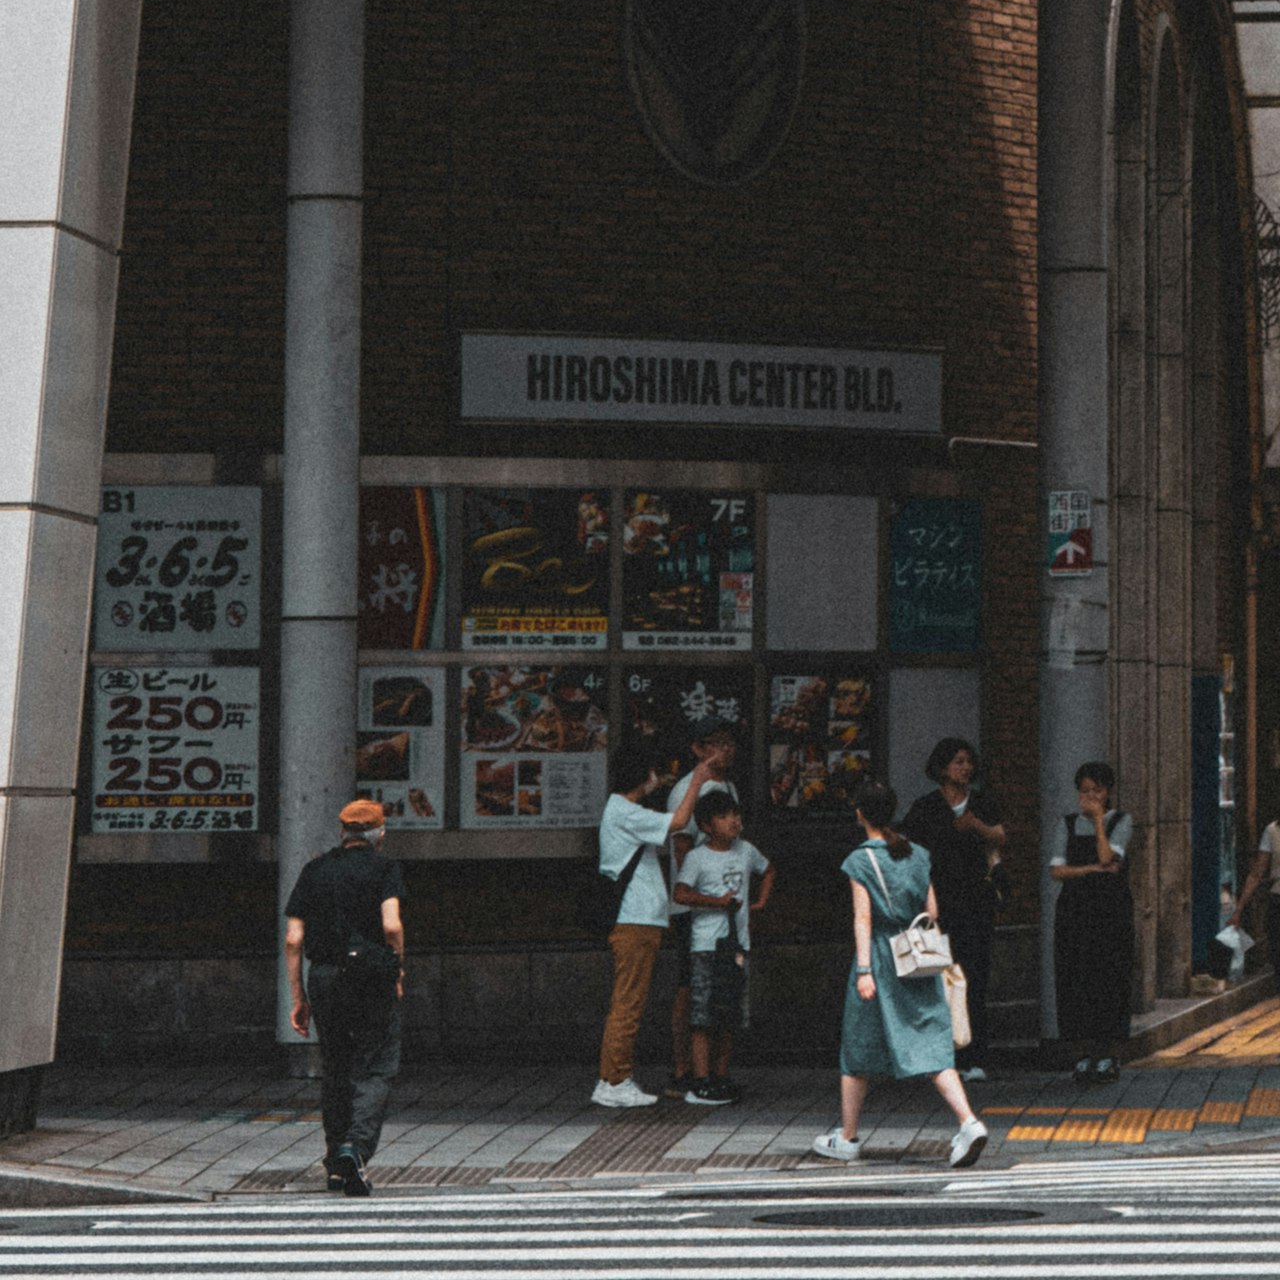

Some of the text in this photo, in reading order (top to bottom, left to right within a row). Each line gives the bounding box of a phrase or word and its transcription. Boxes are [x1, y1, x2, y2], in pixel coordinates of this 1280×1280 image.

[526, 353, 721, 406] HIROSHIMA
[728, 360, 837, 411] CENTER
[103, 492, 135, 512] B1
[710, 499, 746, 521] 7F
[629, 673, 651, 692] 6F
[103, 734, 214, 755] サワー
